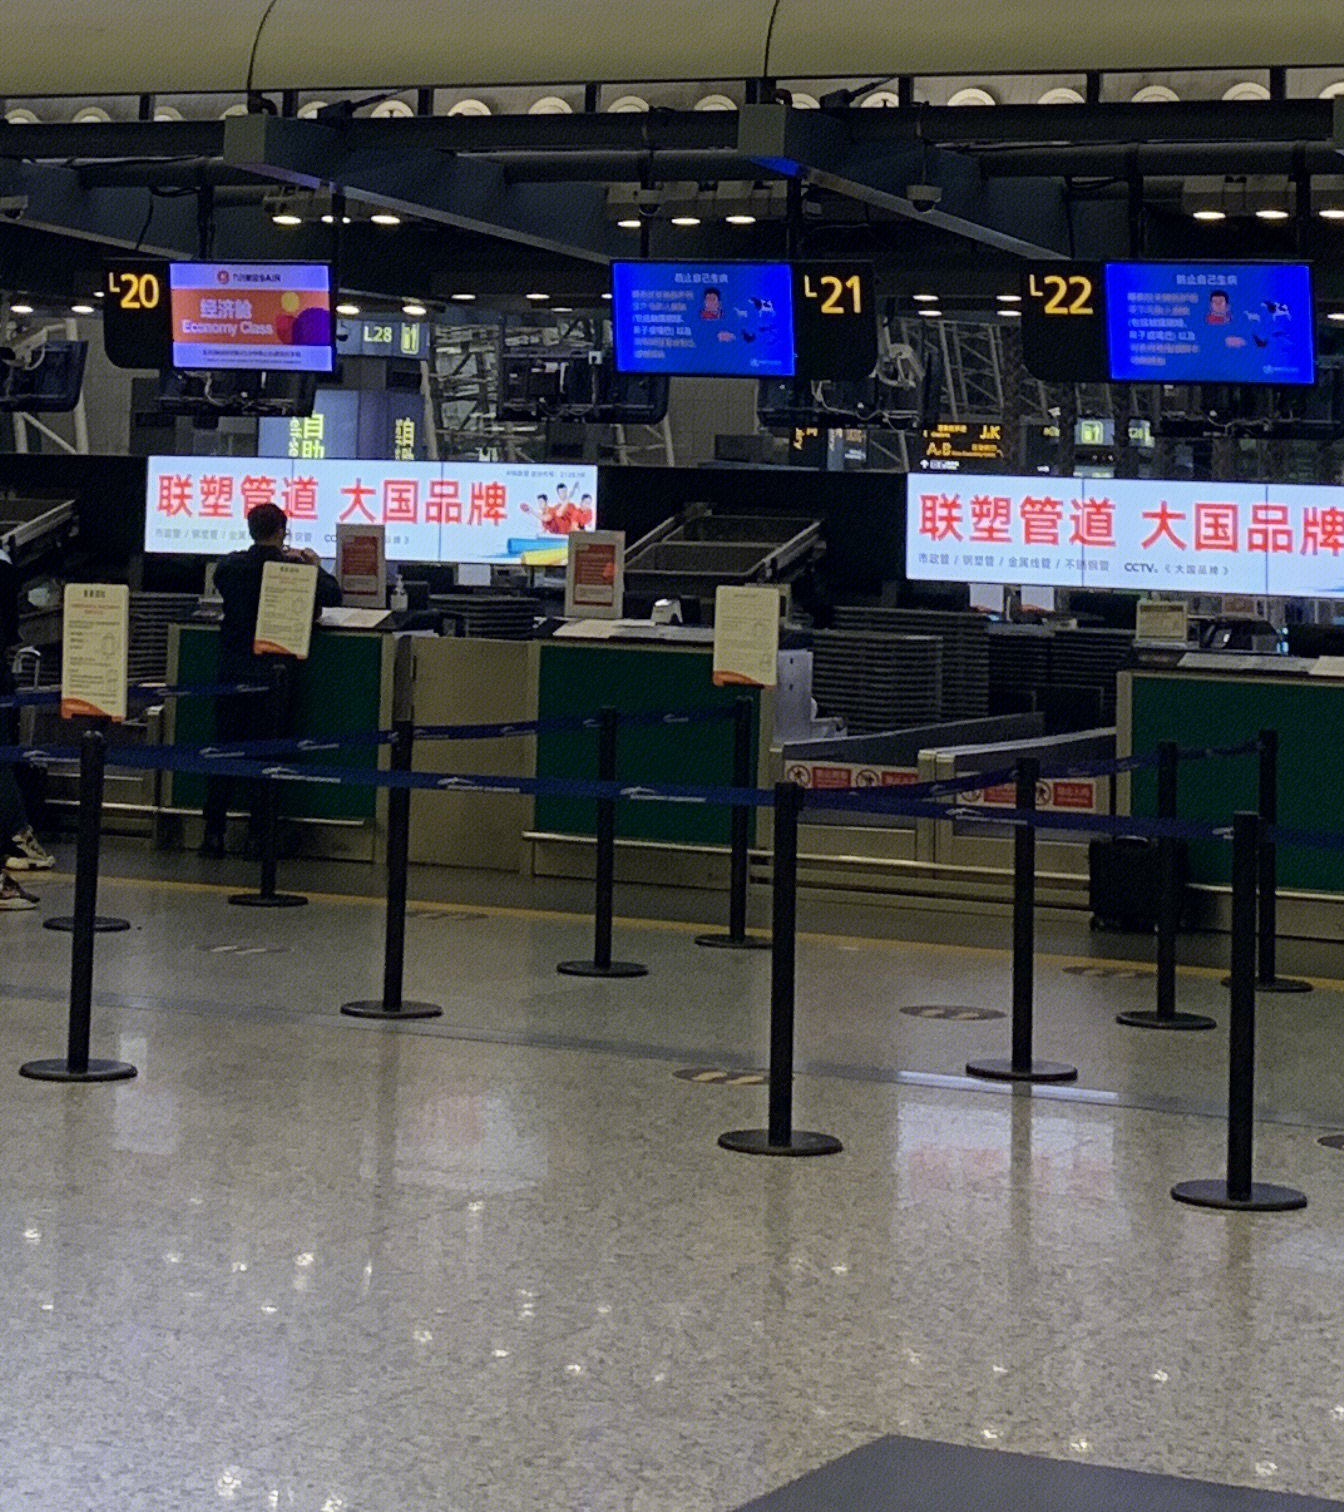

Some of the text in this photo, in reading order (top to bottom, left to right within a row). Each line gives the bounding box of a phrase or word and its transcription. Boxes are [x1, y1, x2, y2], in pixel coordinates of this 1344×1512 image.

[109, 272, 159, 309] L20
[804, 275, 861, 314] L21
[1029, 274, 1094, 315] L22
[182, 320, 273, 337] Economy Class
[363, 326, 392, 343] L28
[158, 475, 508, 525] 联塑管道 大国品牌
[918, 494, 1116, 548] 联塑管道
